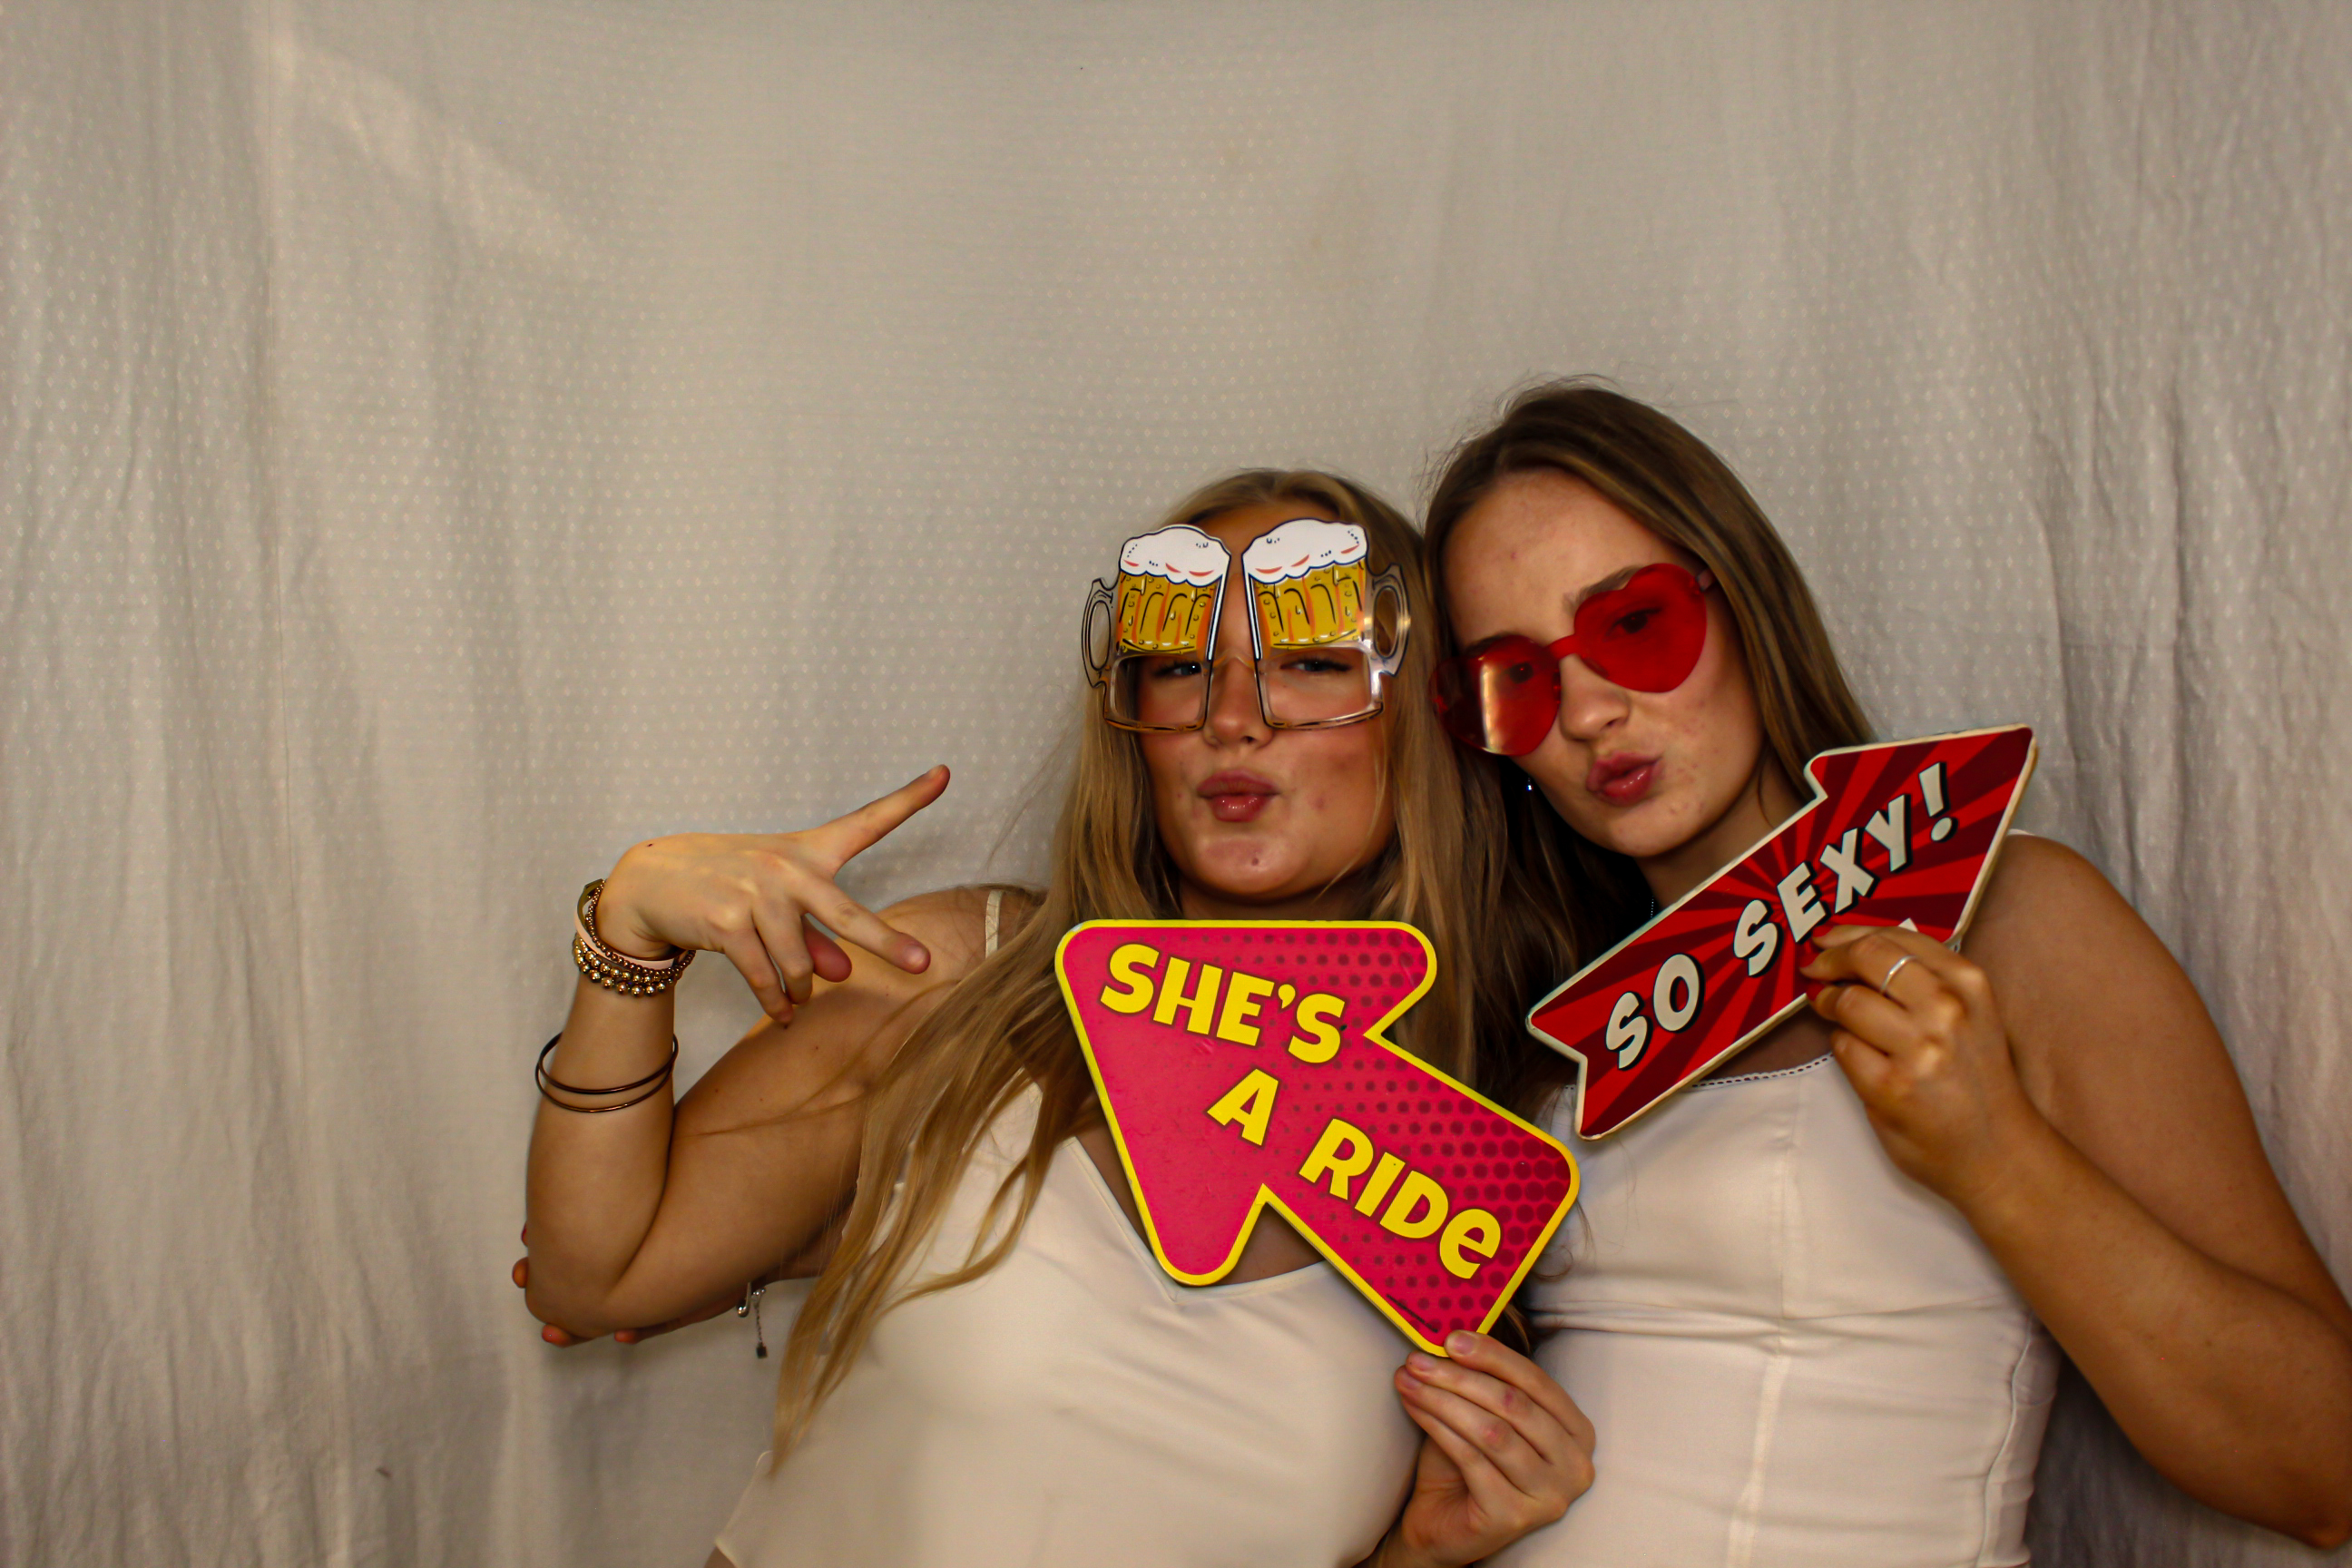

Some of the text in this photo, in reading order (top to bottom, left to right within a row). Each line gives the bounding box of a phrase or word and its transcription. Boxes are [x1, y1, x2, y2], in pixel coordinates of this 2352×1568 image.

[1604, 761, 1956, 1070] SO SEXY!
[1100, 943, 1346, 1064] SHE’S
[1206, 1068, 1279, 1146] A
